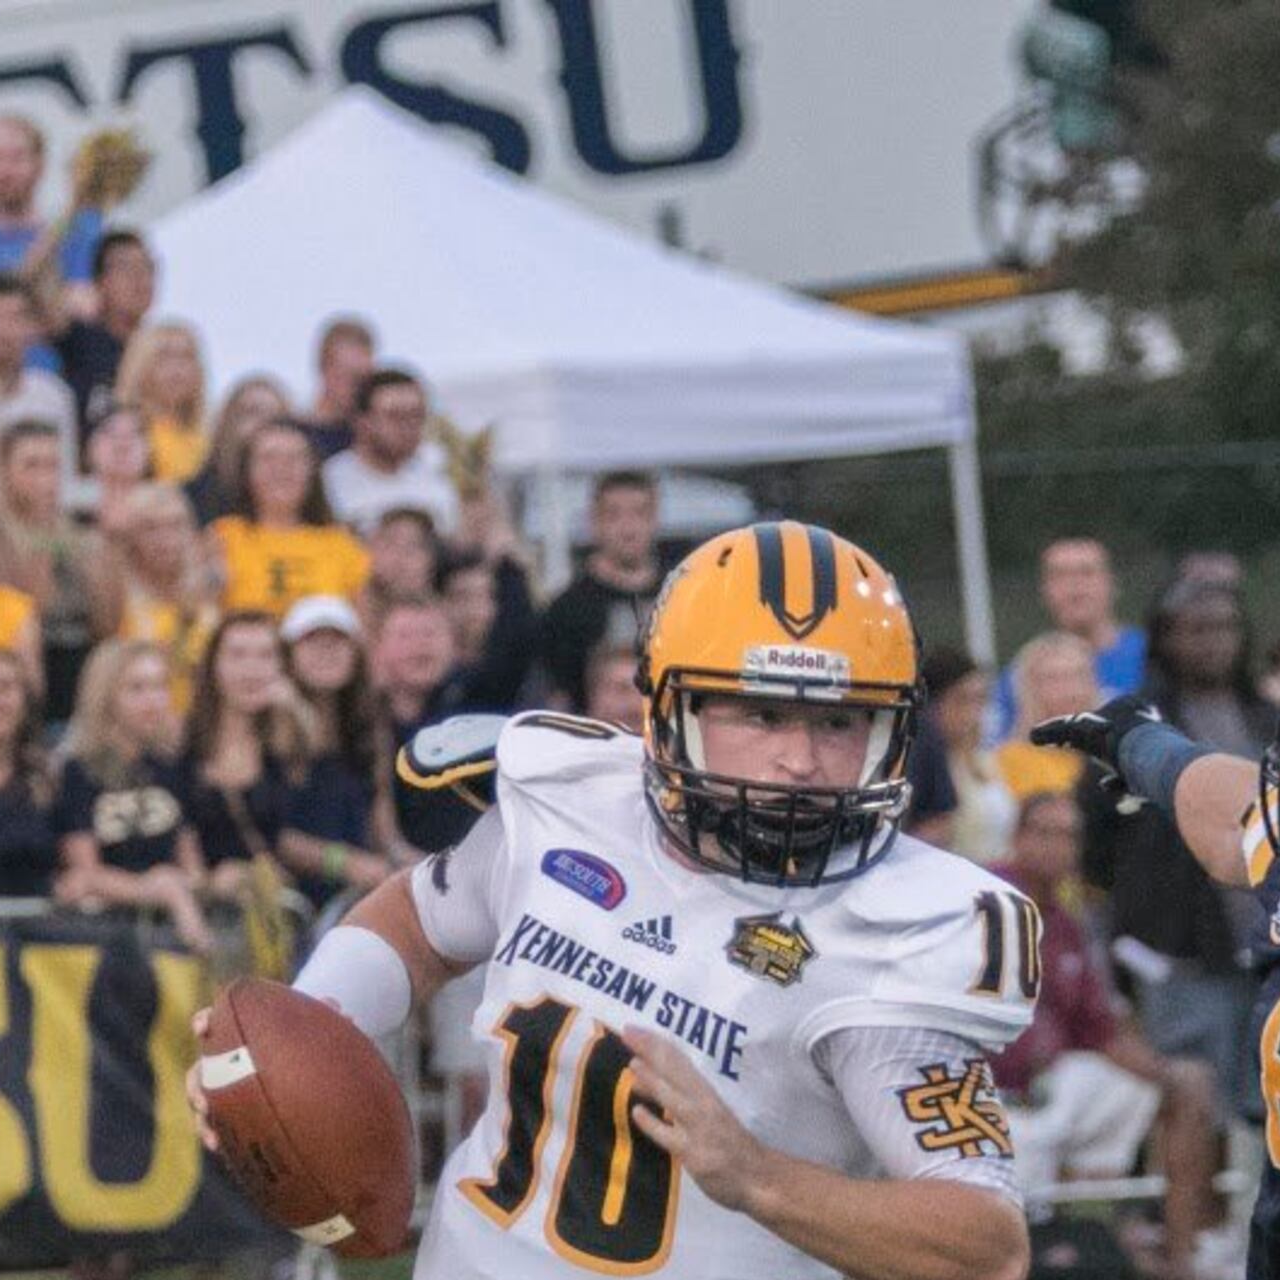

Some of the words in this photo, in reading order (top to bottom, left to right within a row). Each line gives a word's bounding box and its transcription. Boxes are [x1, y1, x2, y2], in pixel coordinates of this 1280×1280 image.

[495, 913, 657, 1012] KENNESAW
[655, 989, 748, 1082] STATE
[621, 925, 677, 955] adidas
[966, 889, 1042, 1000] 10
[459, 991, 683, 1278] 10
